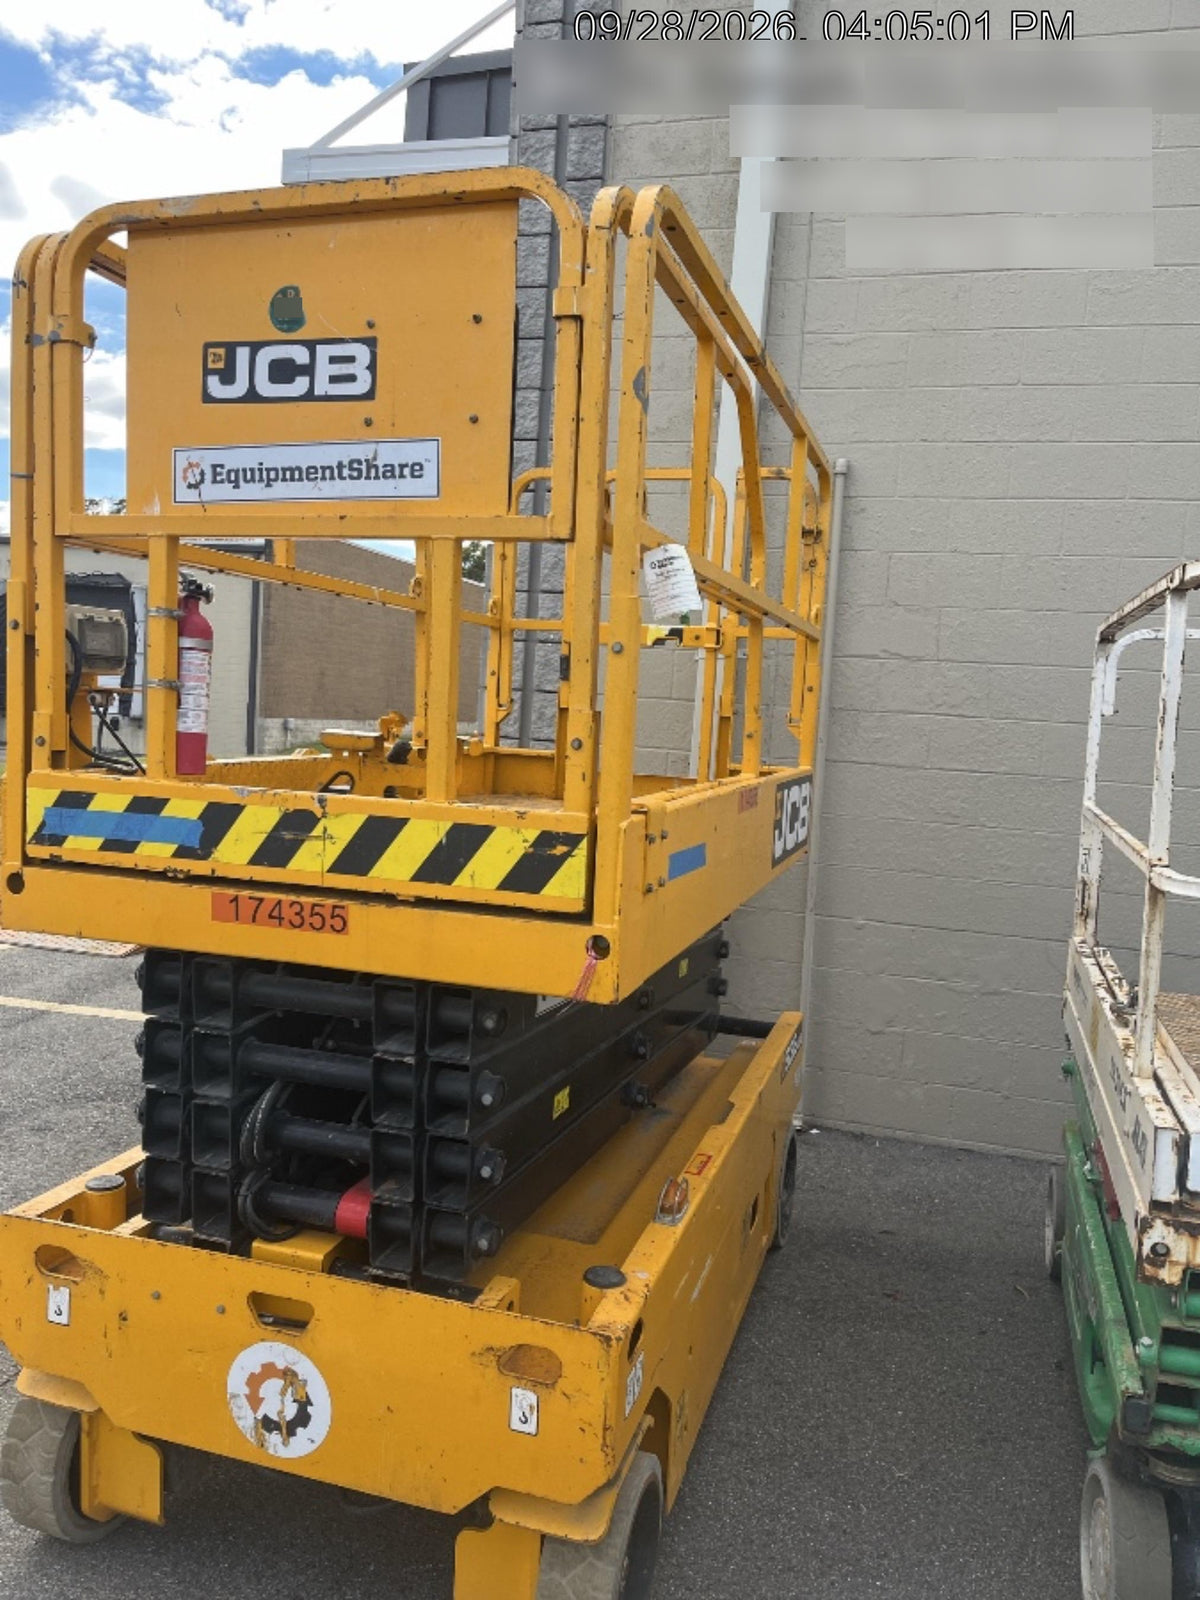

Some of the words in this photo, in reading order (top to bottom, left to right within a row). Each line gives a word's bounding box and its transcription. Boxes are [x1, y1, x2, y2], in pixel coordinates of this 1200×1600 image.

[207, 343, 372, 398] JCB
[774, 781, 810, 859] JCB
[228, 894, 347, 933] 174355
